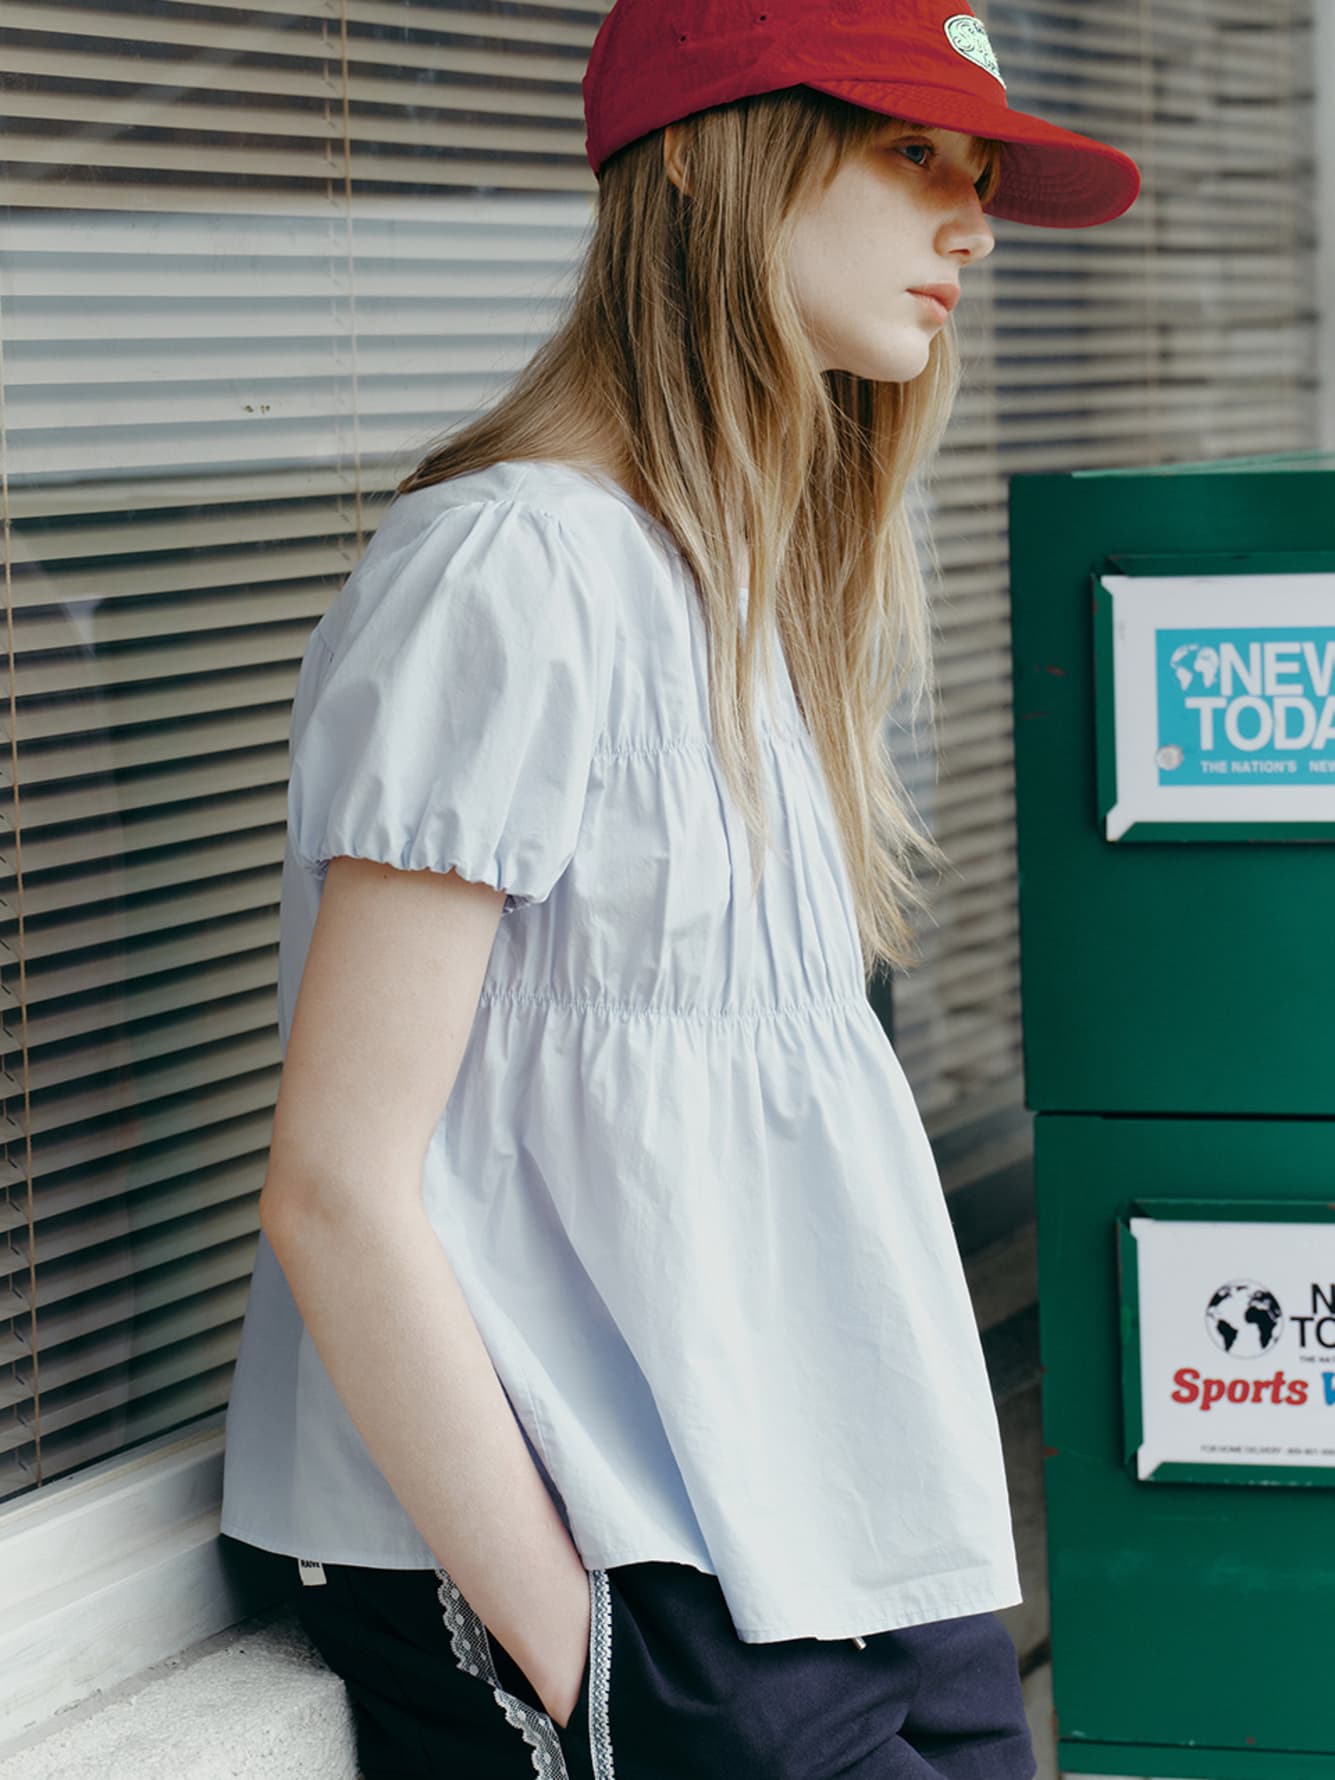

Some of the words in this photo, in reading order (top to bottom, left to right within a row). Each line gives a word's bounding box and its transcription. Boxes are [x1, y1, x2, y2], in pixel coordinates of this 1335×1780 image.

[1201, 760, 1228, 773] THE
[1231, 760, 1297, 773] NATION'S
[1171, 1367, 1309, 1412] Sports
